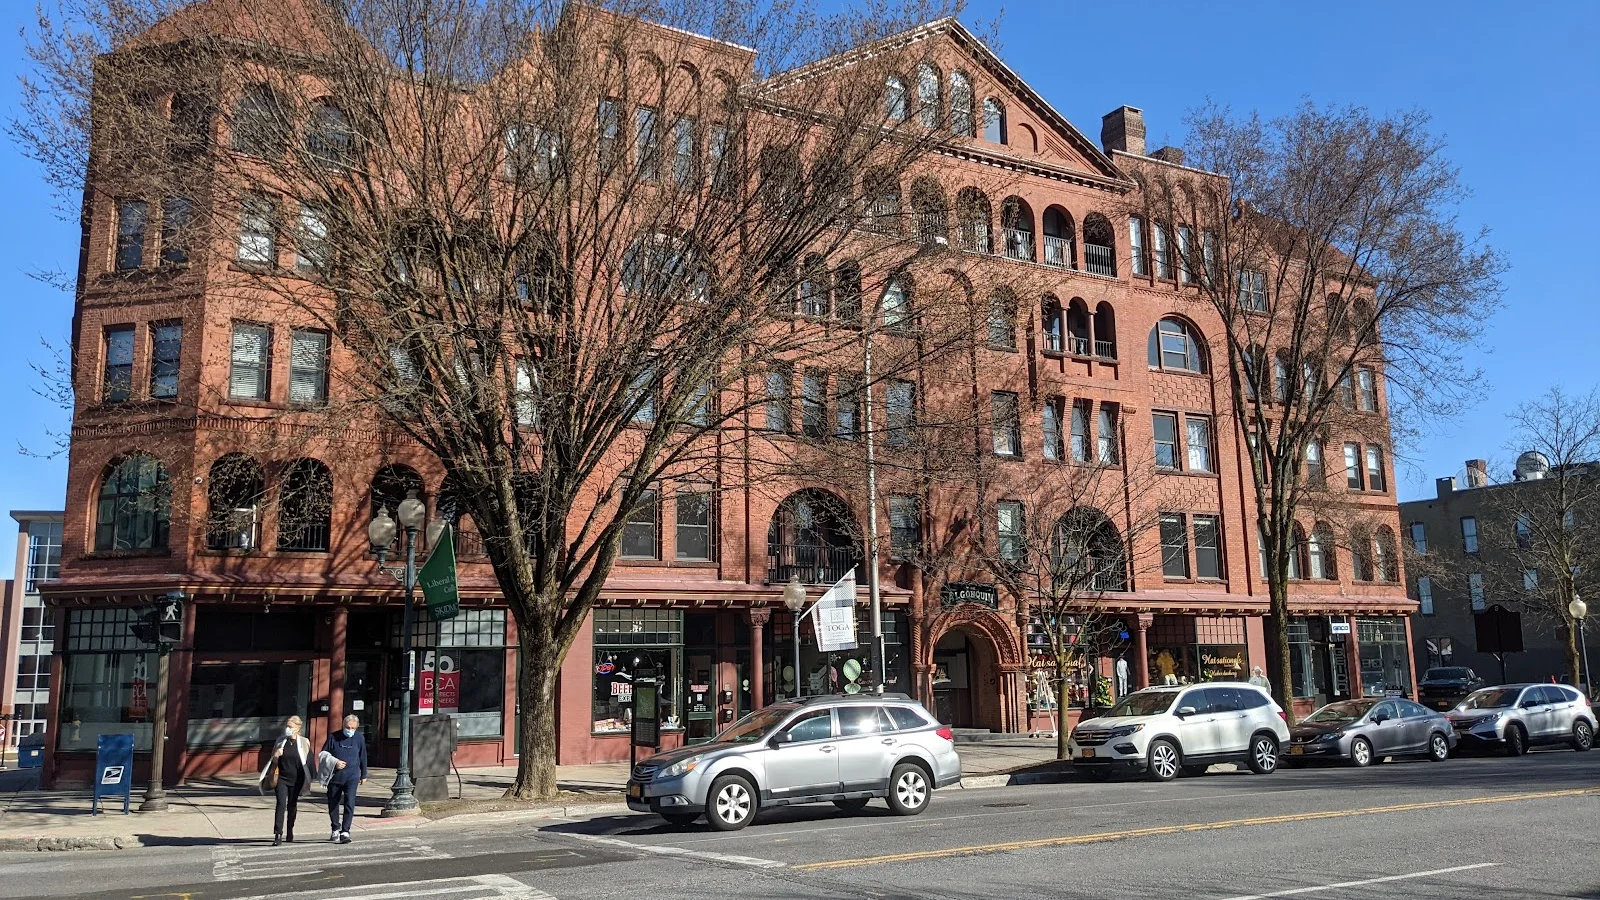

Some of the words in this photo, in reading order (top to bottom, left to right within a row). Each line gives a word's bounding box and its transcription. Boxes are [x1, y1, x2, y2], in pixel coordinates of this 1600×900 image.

[427, 576, 450, 588] Liberal
[424, 651, 455, 672] 50
[424, 677, 456, 691] BCA
